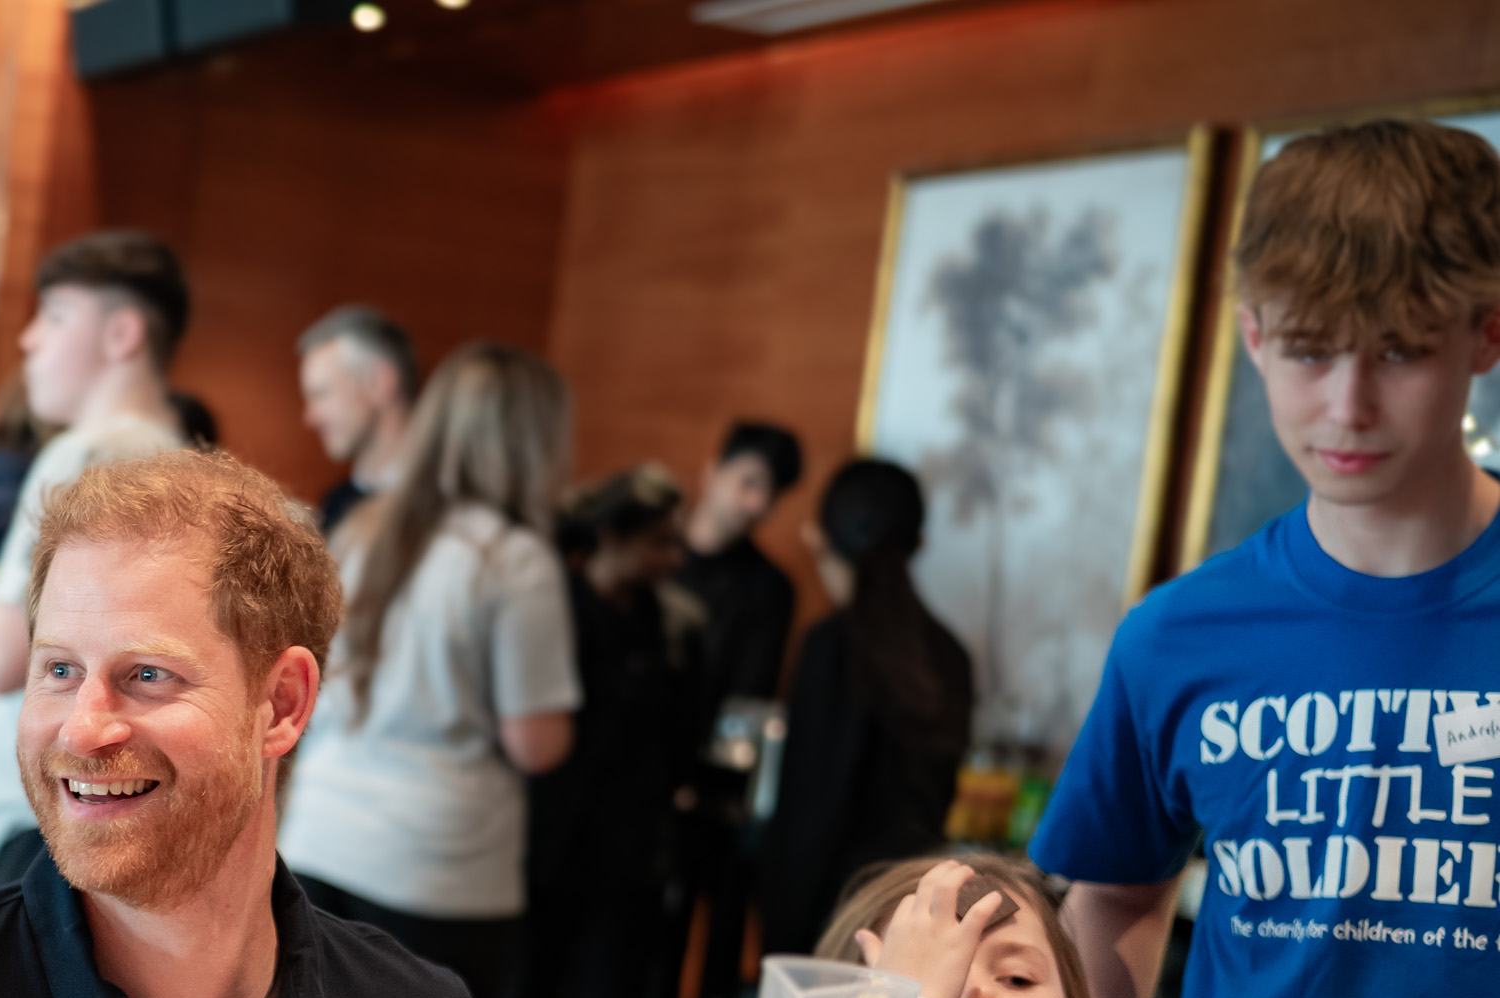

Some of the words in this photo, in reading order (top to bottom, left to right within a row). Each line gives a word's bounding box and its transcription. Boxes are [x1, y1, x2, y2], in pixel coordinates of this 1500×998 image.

[1265, 764, 1494, 827] LITTLE
[1333, 919, 1416, 944] children
[1422, 927, 1446, 948] of
[1452, 927, 1488, 951] the
